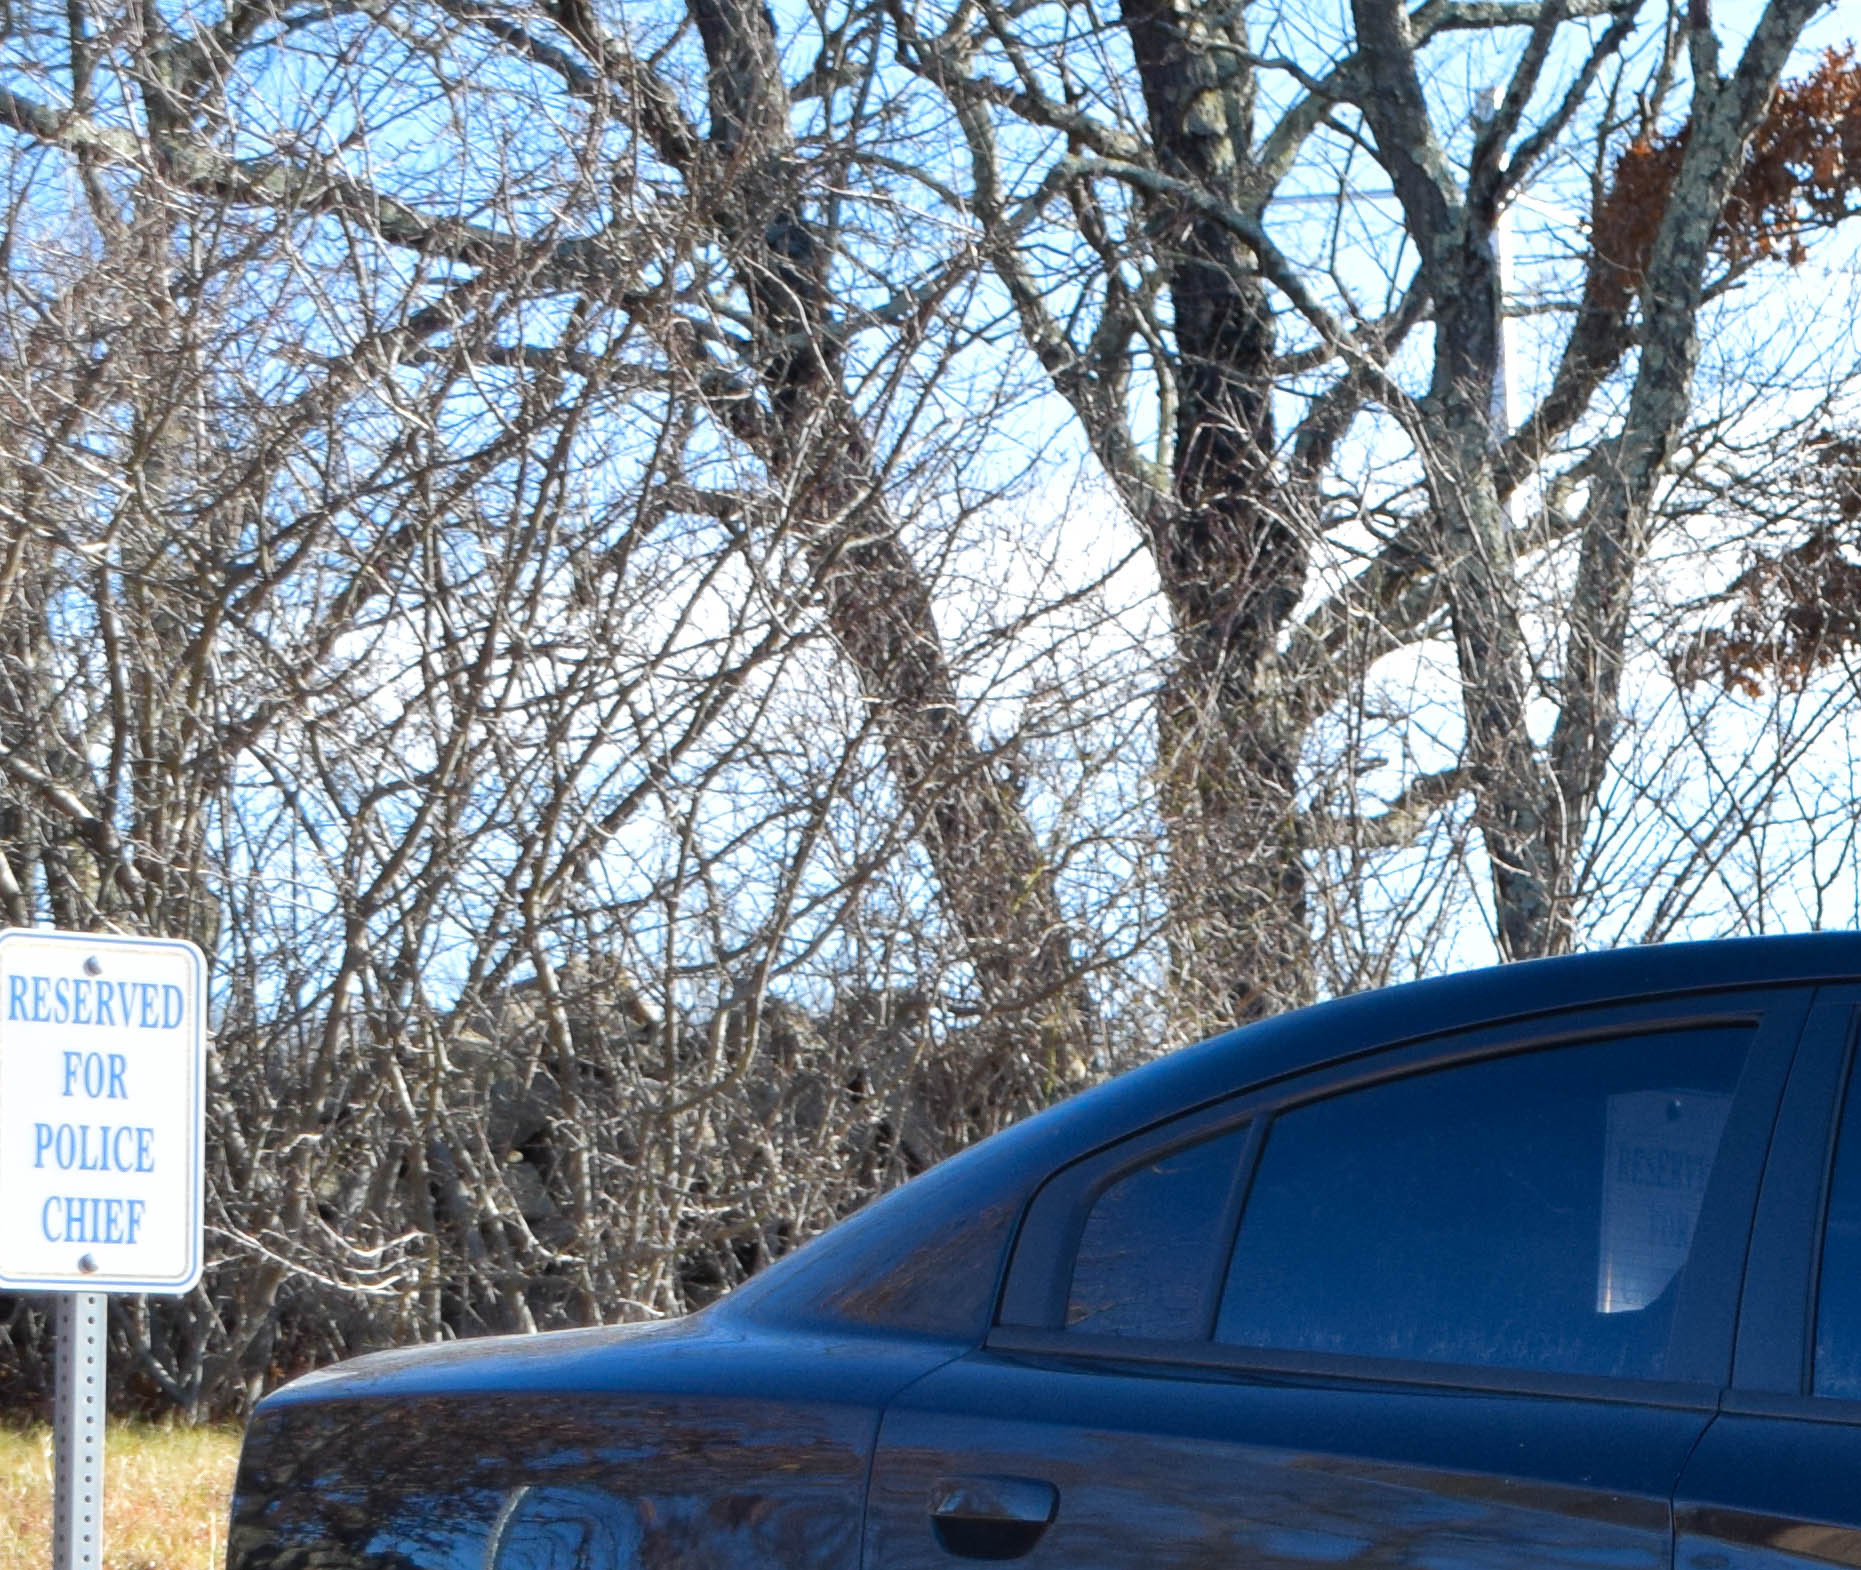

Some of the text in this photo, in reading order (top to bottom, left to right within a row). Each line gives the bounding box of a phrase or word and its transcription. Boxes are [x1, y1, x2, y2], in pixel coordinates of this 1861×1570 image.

[8, 974, 185, 1029] RESERVED
[62, 1051, 128, 1099] FOR
[32, 1122, 155, 1173] POLICE
[41, 1195, 146, 1244] CHIEF
